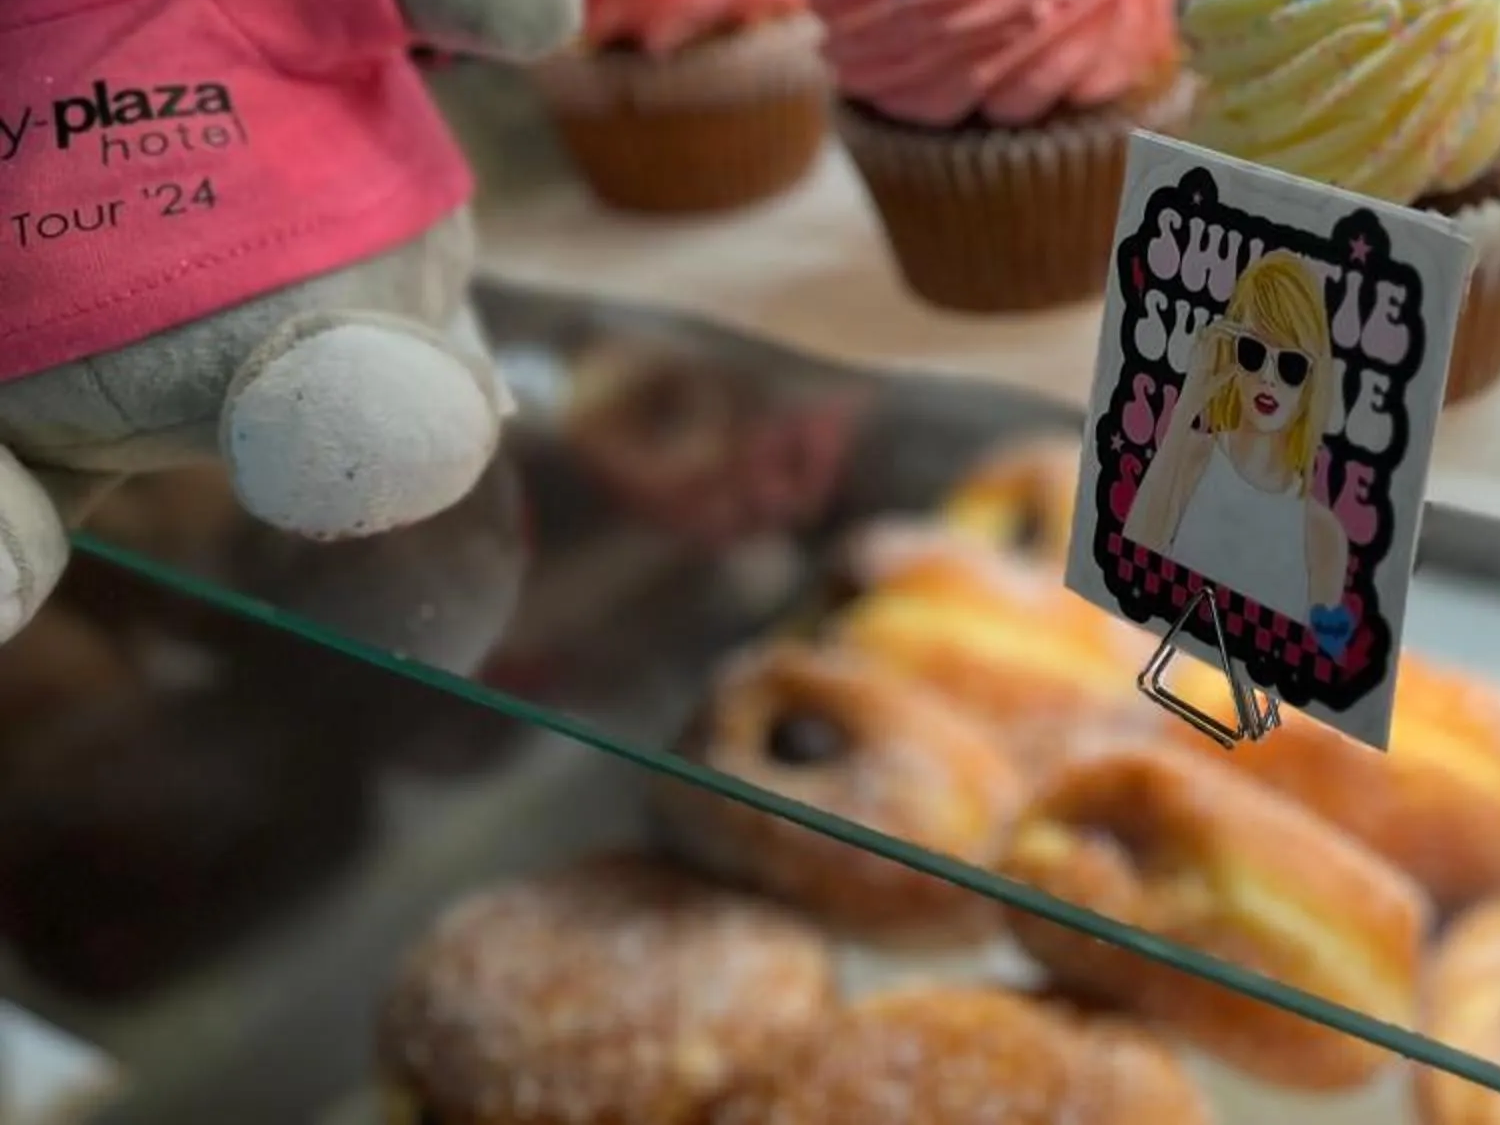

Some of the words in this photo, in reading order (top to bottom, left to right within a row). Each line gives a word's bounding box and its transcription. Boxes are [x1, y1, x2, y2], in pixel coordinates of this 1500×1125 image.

[101, 112, 248, 166] hotel
[11, 200, 125, 248] Tour
[142, 177, 217, 217] '24
